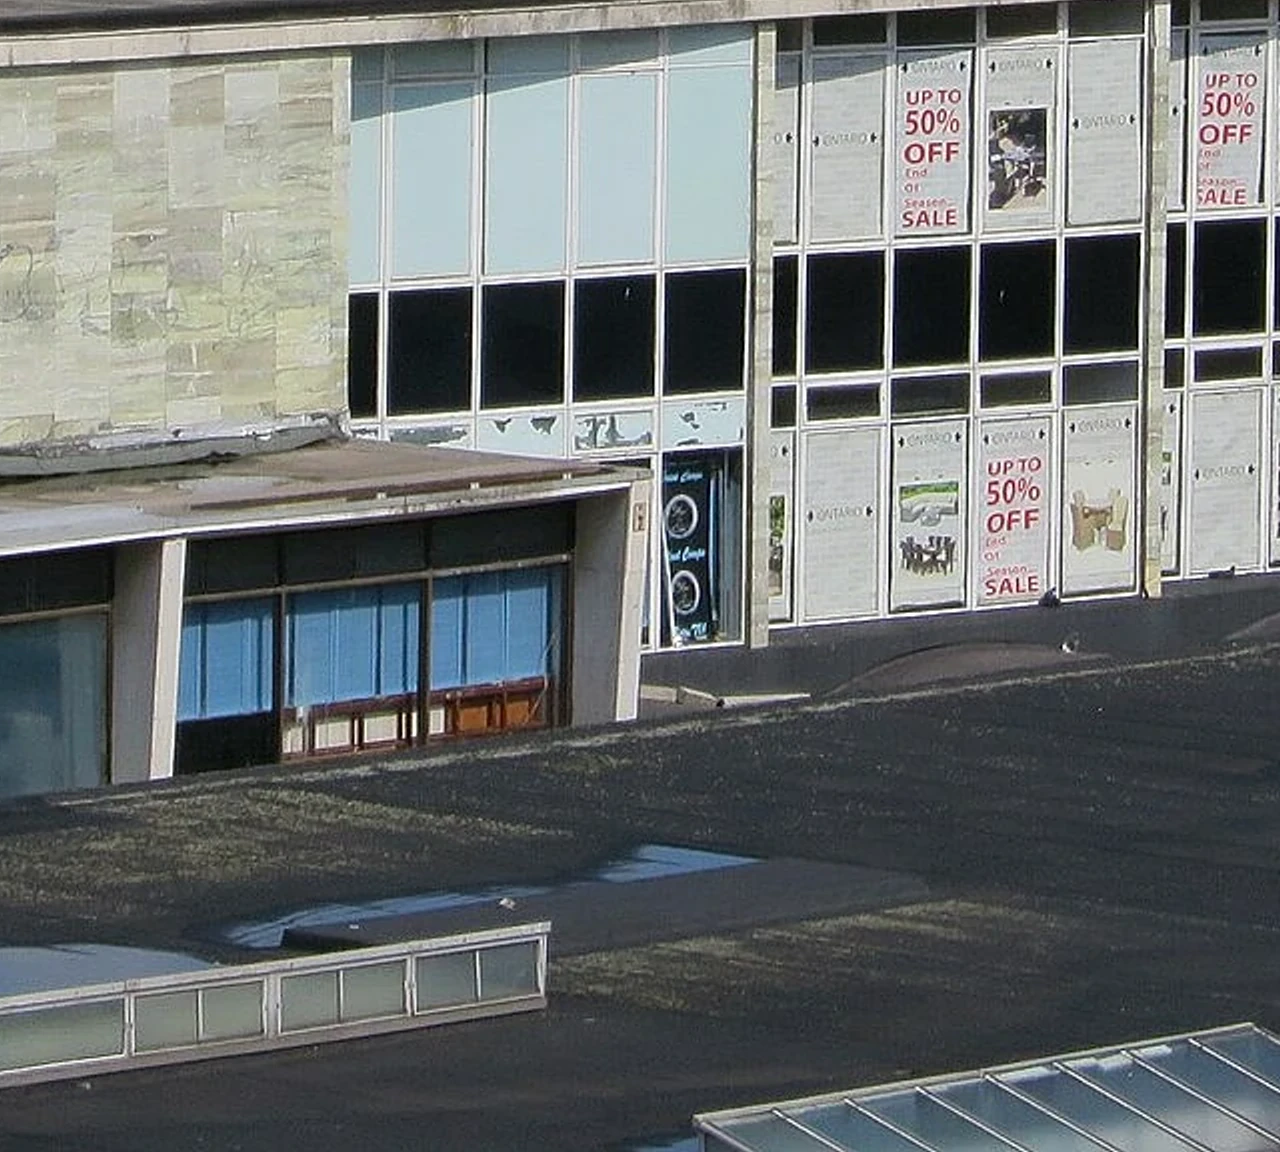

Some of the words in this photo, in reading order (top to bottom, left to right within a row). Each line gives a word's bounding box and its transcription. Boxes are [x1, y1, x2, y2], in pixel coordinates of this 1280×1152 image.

[1206, 74, 1230, 88] UP
[1236, 73, 1257, 88] TO
[906, 91, 932, 106] UP
[938, 89, 962, 105] TO
[1202, 91, 1255, 117] 50%
[905, 109, 960, 135] 50%
[1199, 124, 1253, 145] OFF
[904, 142, 959, 164] OFF
[902, 210, 957, 228] SALE
[988, 461, 1013, 476] UP
[1017, 457, 1042, 472] TO
[986, 477, 1040, 506] 50%
[987, 508, 1040, 533] OFF
[985, 576, 1039, 596] SALE
